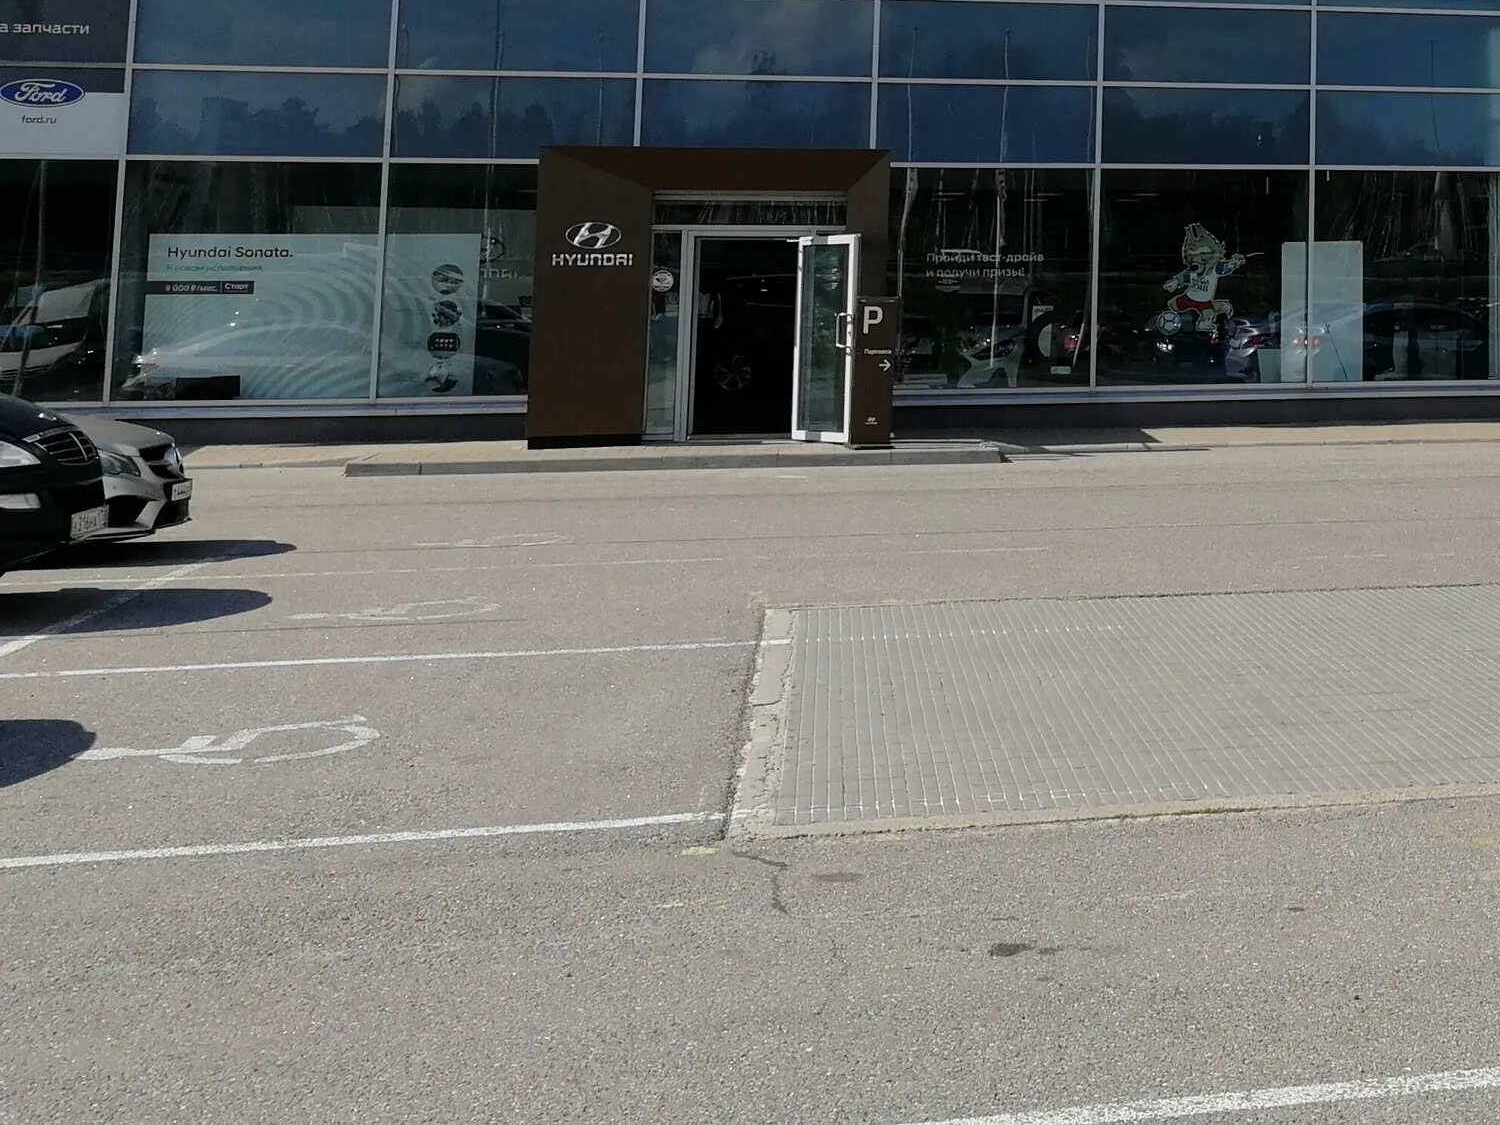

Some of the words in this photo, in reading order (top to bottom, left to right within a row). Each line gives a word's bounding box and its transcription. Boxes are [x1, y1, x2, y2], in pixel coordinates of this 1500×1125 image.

[12, 24, 90, 34] запчасти
[14, 82, 68, 102] Ford
[22, 115, 57, 124] ford.ru
[167, 246, 231, 259] Hyundai
[235, 246, 293, 258] Sonata.
[552, 254, 633, 266] HYUNDAI
[983, 267, 1025, 278] призы!
[224, 282, 249, 290] Старт
[863, 306, 883, 334] P
